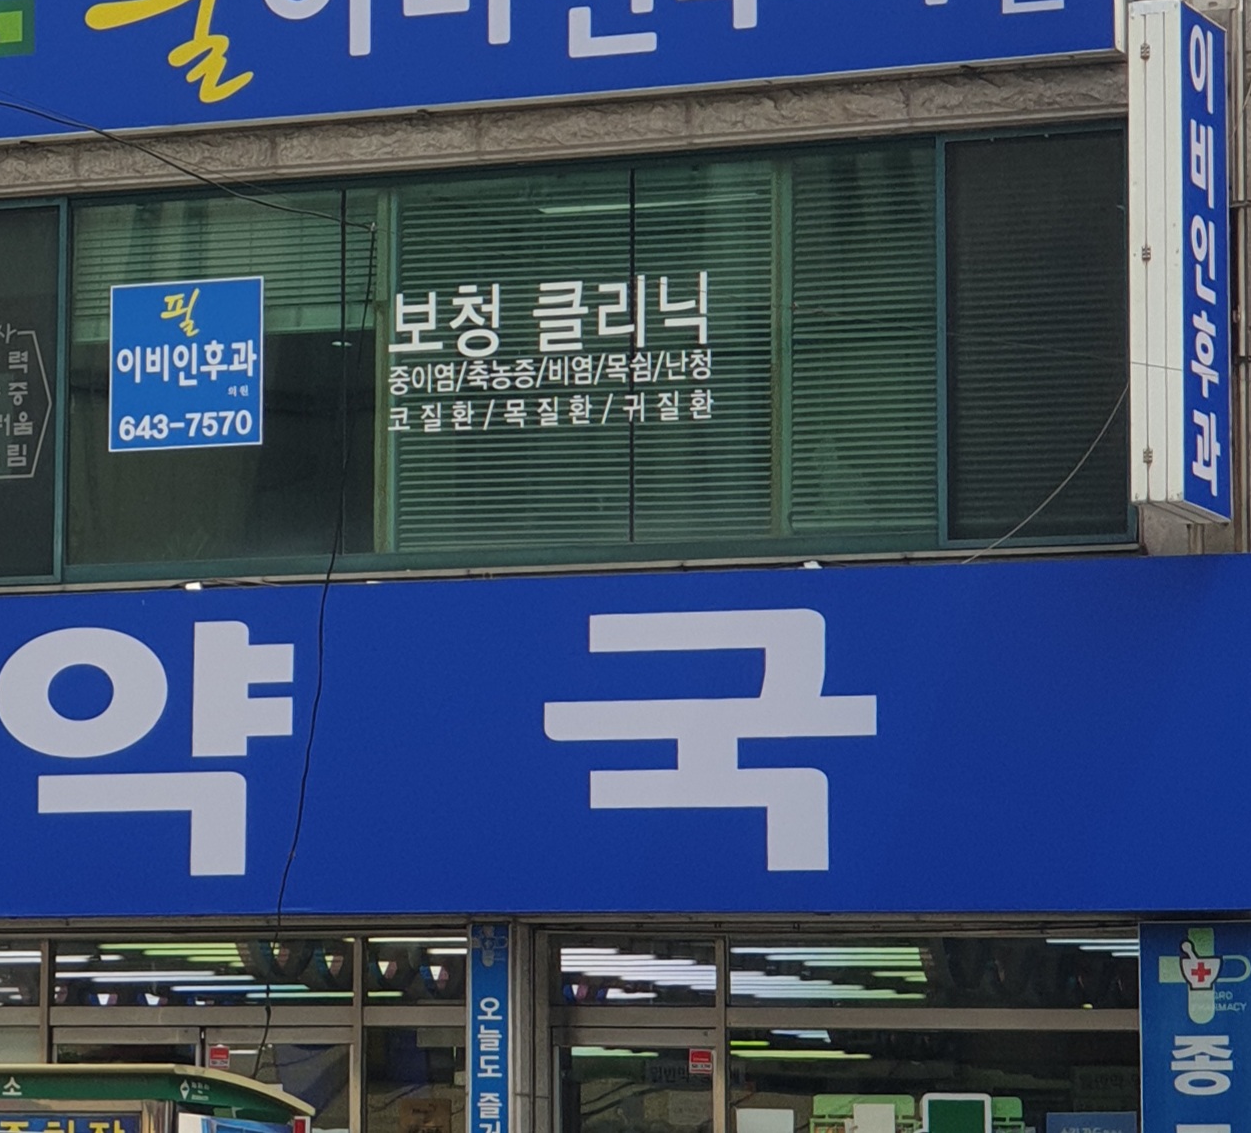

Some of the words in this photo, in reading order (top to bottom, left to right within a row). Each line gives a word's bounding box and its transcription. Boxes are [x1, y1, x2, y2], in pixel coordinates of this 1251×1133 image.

[1189, 24, 1222, 498] 이비인후과
[160, 288, 200, 337] 필
[388, 283, 500, 357] 보청
[532, 271, 708, 352] 클리닉
[117, 339, 257, 386] 이비인후과
[119, 410, 253, 441] 643-7570
[477, 996, 503, 1079] 오늘도
